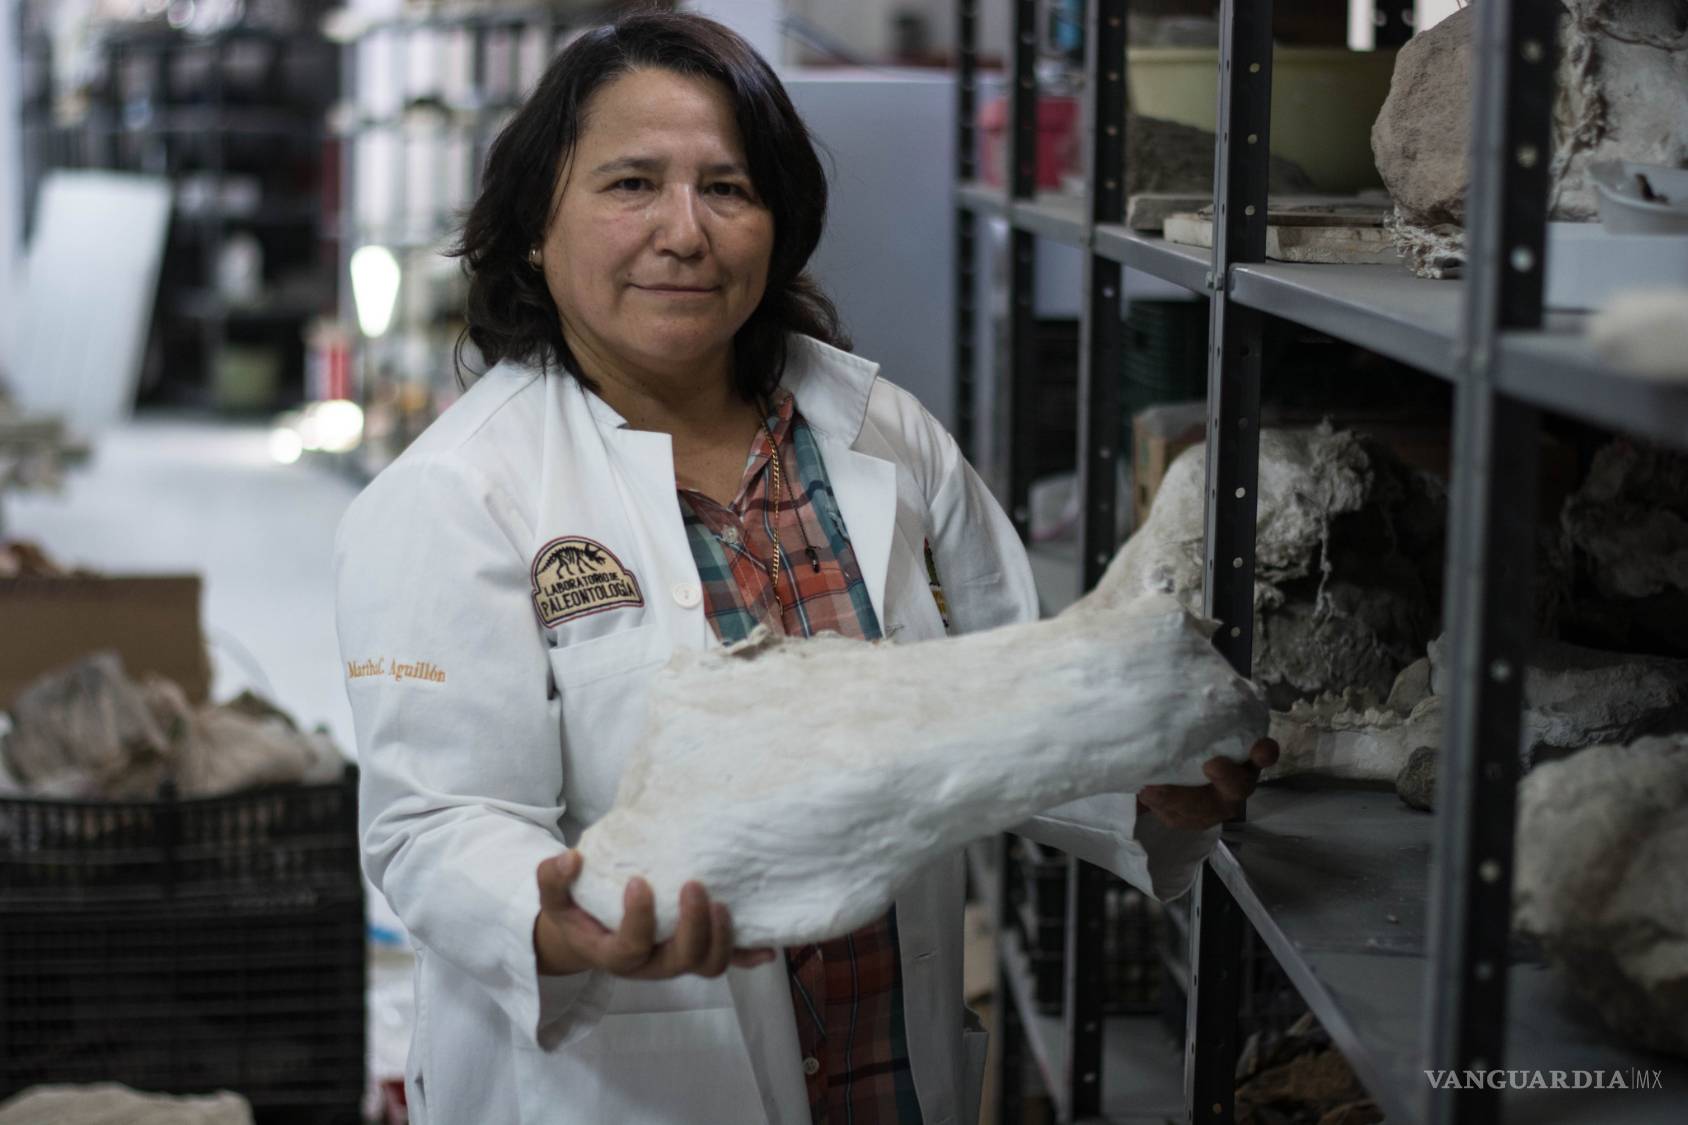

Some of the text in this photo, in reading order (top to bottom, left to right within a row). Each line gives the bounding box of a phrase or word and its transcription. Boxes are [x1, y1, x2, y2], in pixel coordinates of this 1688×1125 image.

[544, 571, 620, 597] LABORATORIO DE
[541, 580, 634, 617] PALEONTOLOGÍA
[388, 658, 446, 682] Aguillón
